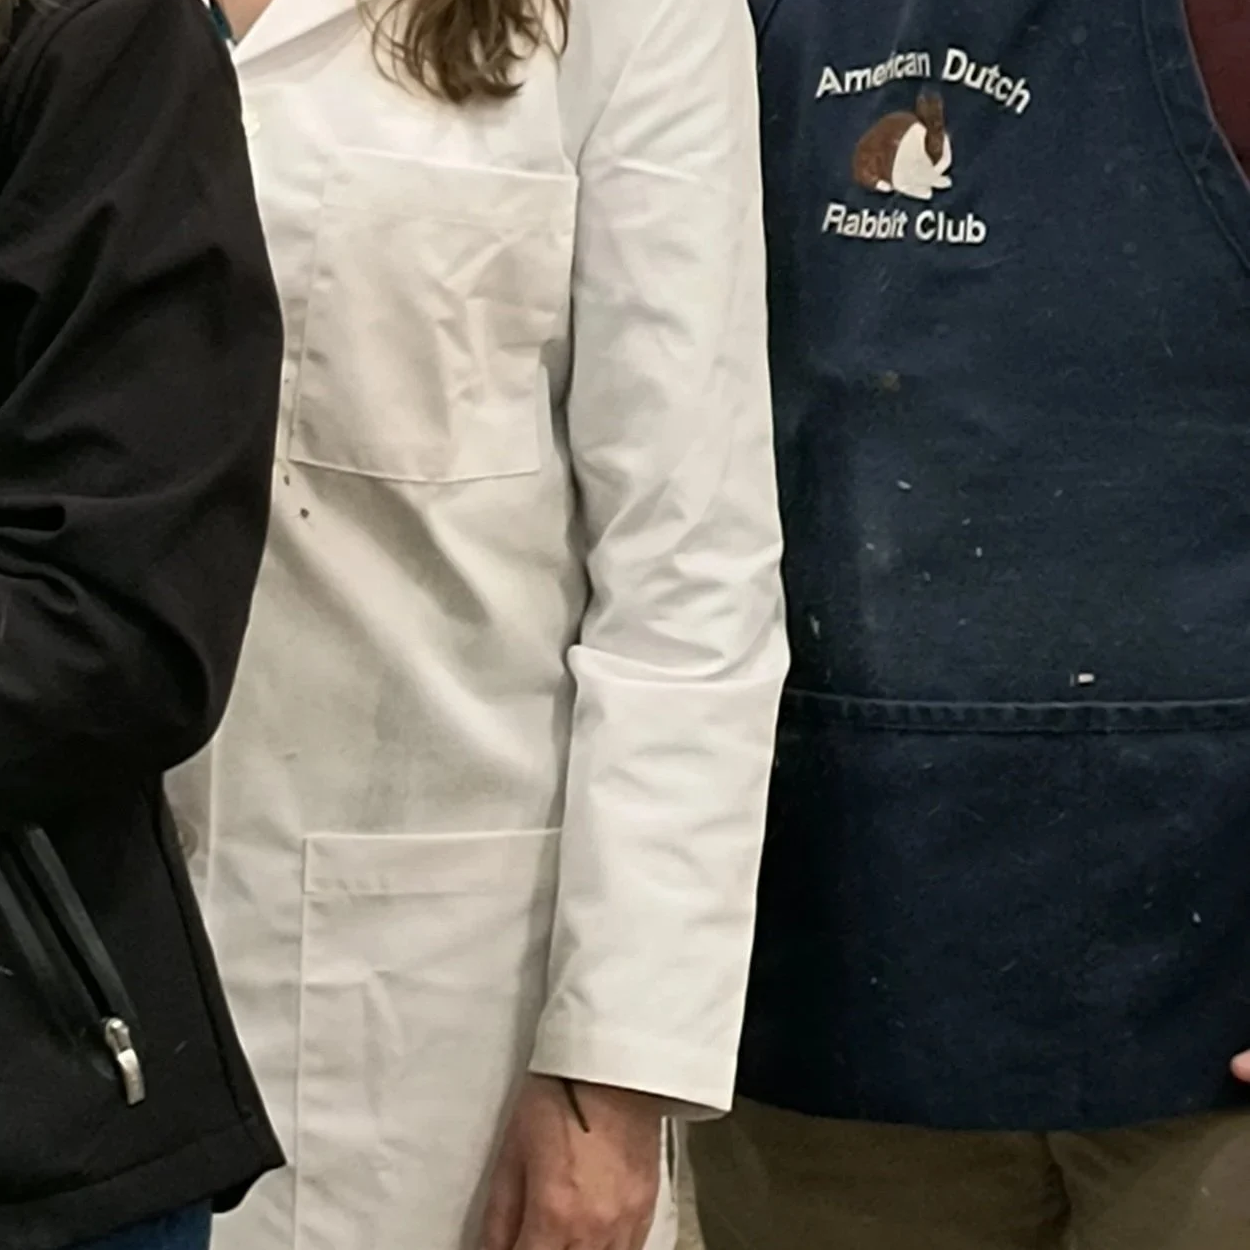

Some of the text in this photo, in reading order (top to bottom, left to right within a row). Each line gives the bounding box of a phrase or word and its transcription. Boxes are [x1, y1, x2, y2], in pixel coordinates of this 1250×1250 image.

[815, 48, 1031, 114] American Dutch
[822, 202, 987, 243] Rabbit Club
